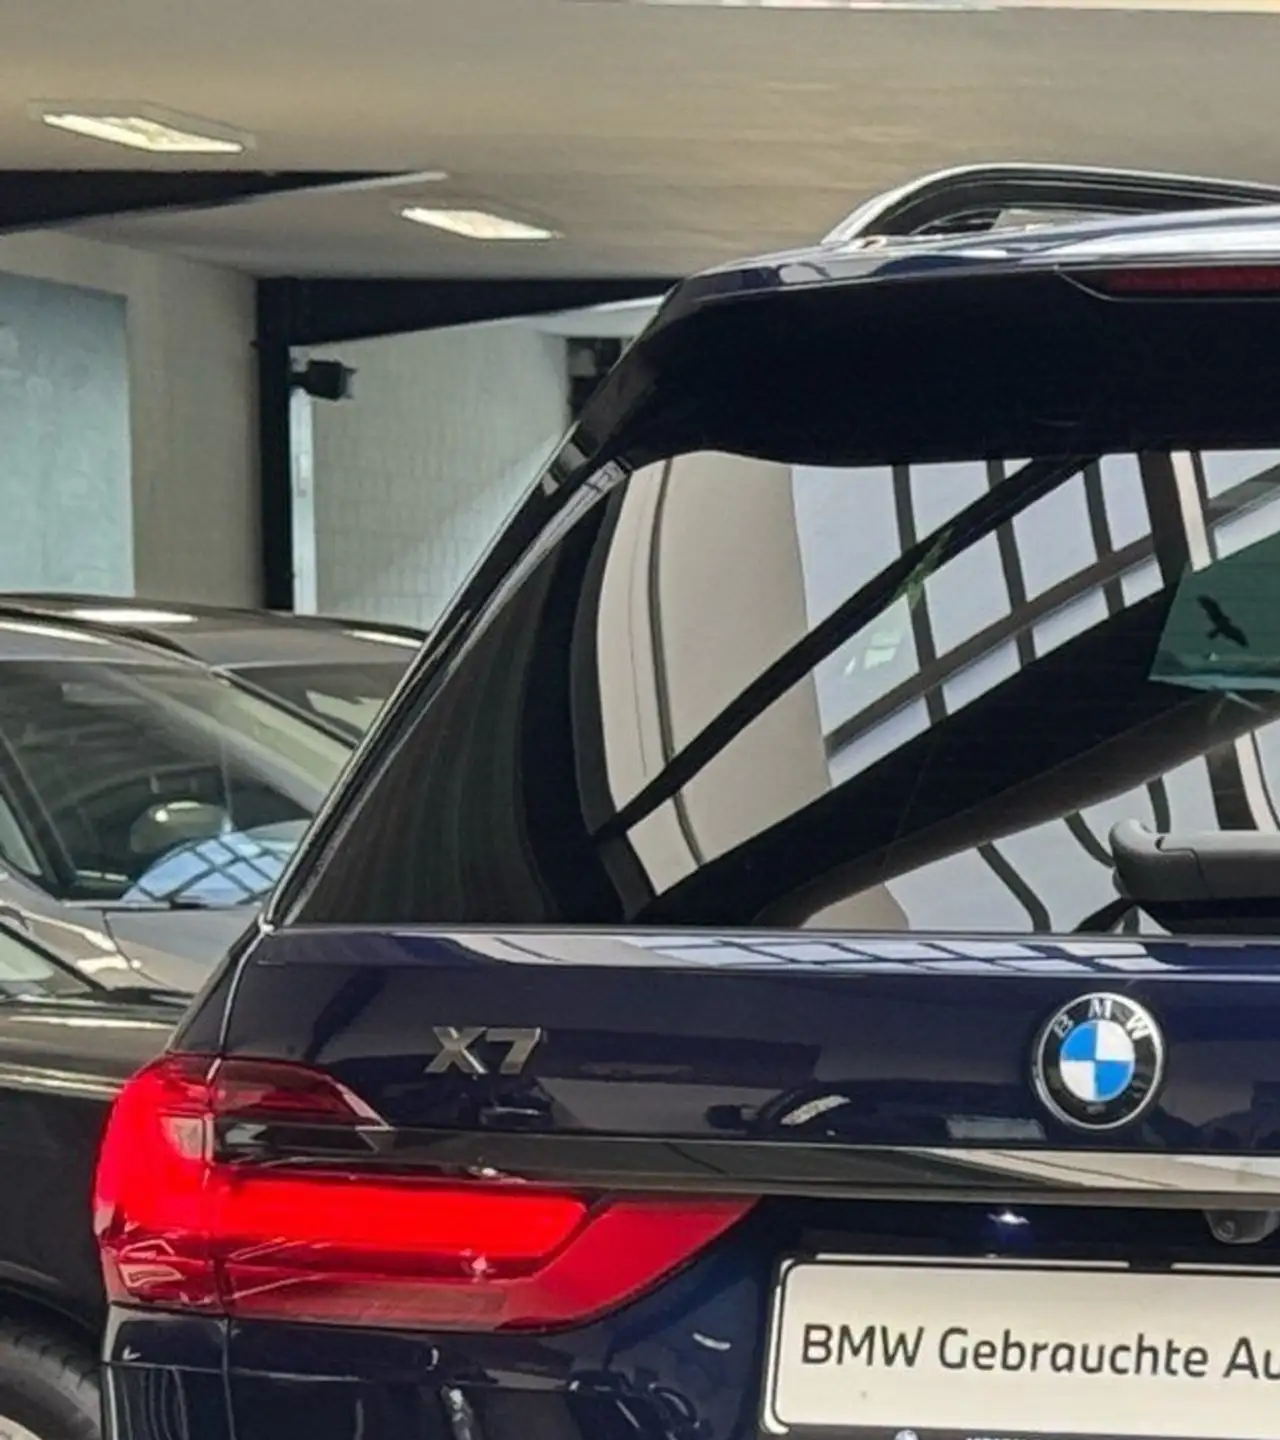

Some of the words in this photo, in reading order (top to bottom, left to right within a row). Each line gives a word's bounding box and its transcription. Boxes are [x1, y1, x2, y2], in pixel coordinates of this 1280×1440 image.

[1052, 998, 1152, 1040] BMW
[423, 1026, 542, 1075] X7
[801, 1323, 925, 1367] BMW
[938, 1327, 1209, 1378] Gebrauchte
